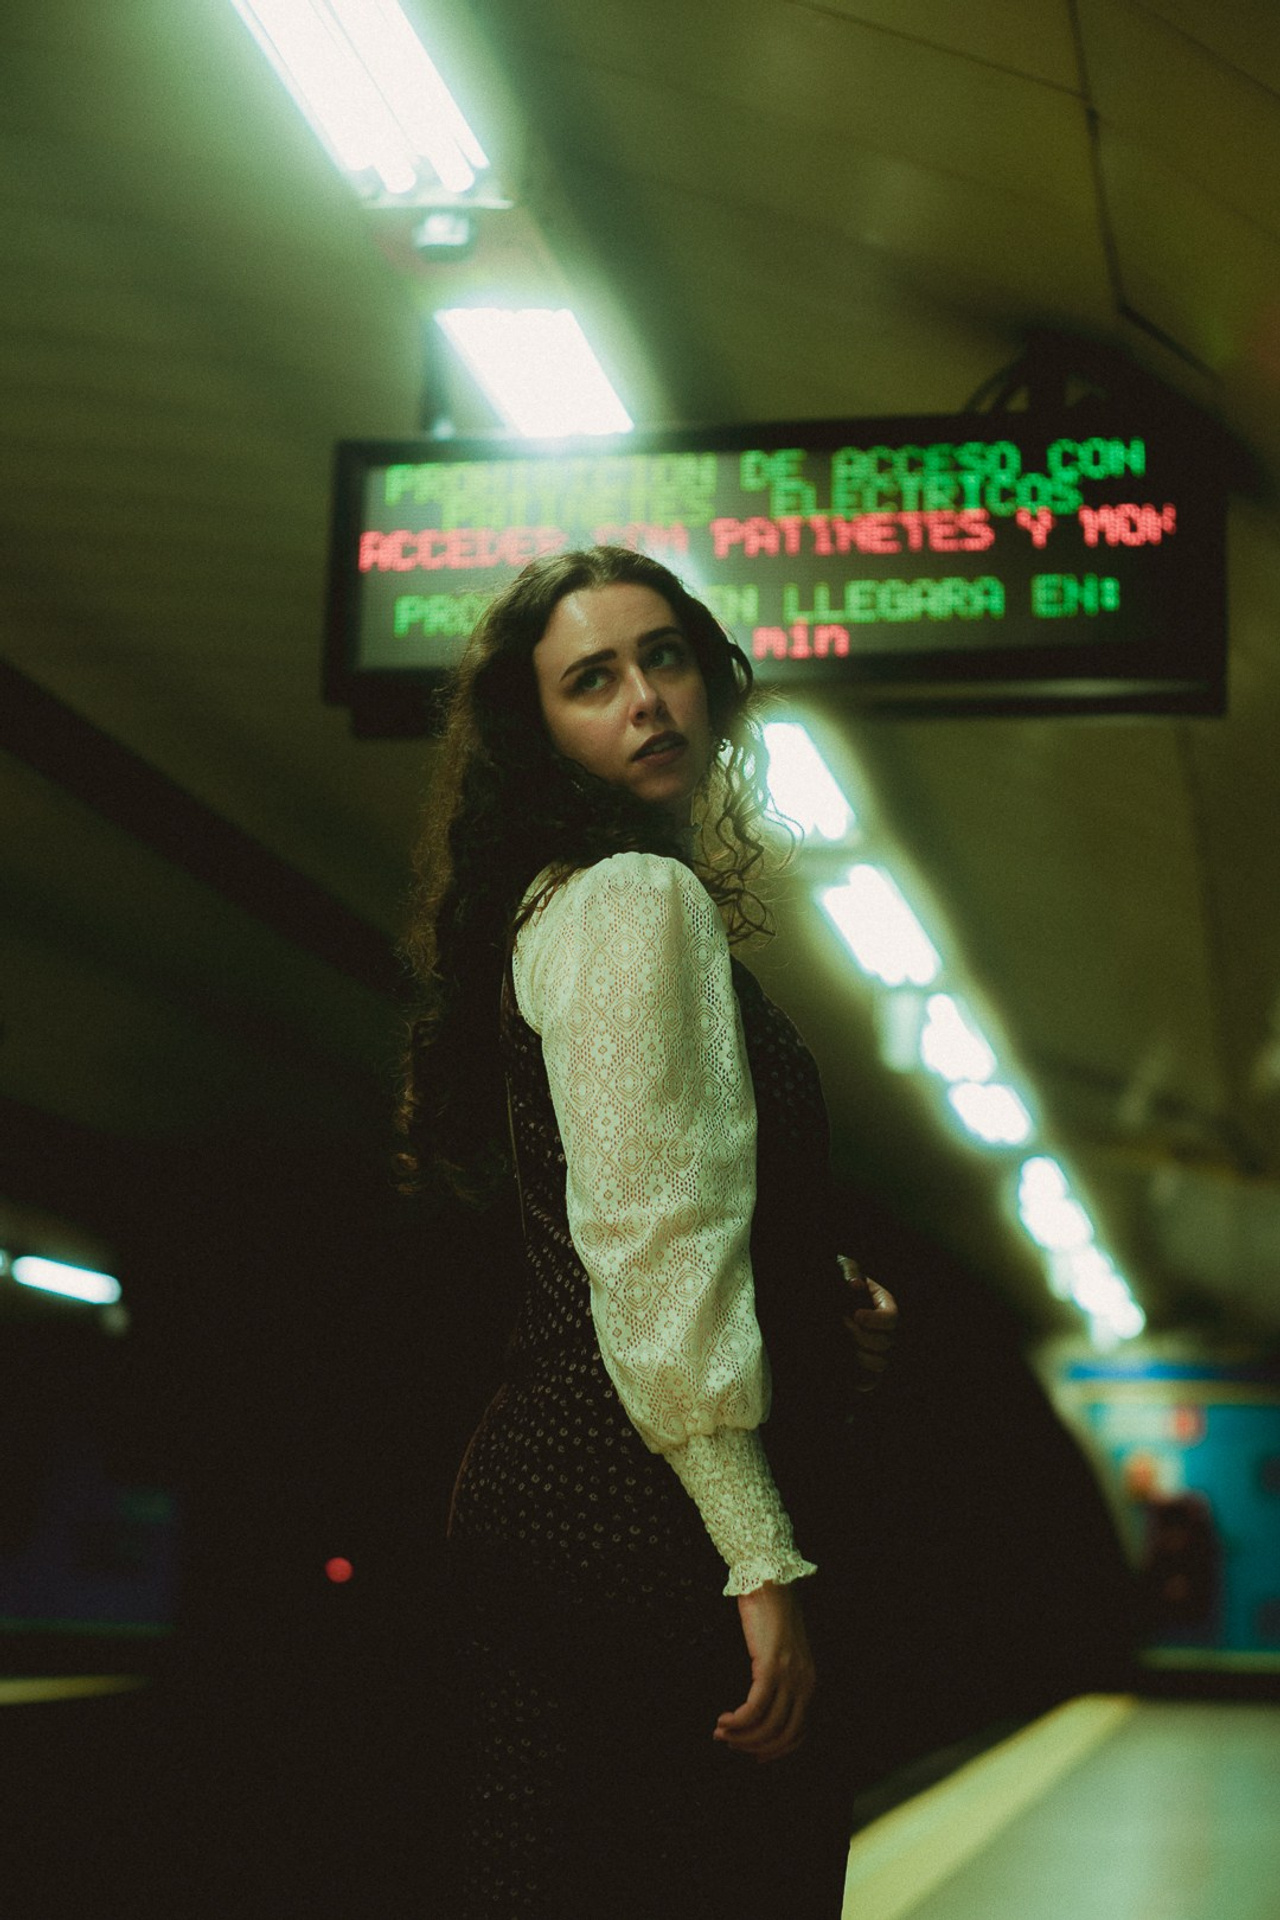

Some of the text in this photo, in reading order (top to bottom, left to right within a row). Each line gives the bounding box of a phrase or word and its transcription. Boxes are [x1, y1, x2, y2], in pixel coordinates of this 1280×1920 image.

[740, 449, 807, 492] DE
[832, 440, 1021, 487] ACCESO
[1047, 436, 1146, 482] CON
[770, 471, 1083, 520] ELECTRICOS
[358, 525, 567, 573] ACCEDER
[710, 507, 996, 559] PATINETES
[1015, 504, 1056, 549] Y
[394, 593, 487, 639] PRO
[783, 576, 1005, 625] LLEGARA
[1031, 573, 1120, 618] EN:
[752, 617, 850, 660] min
